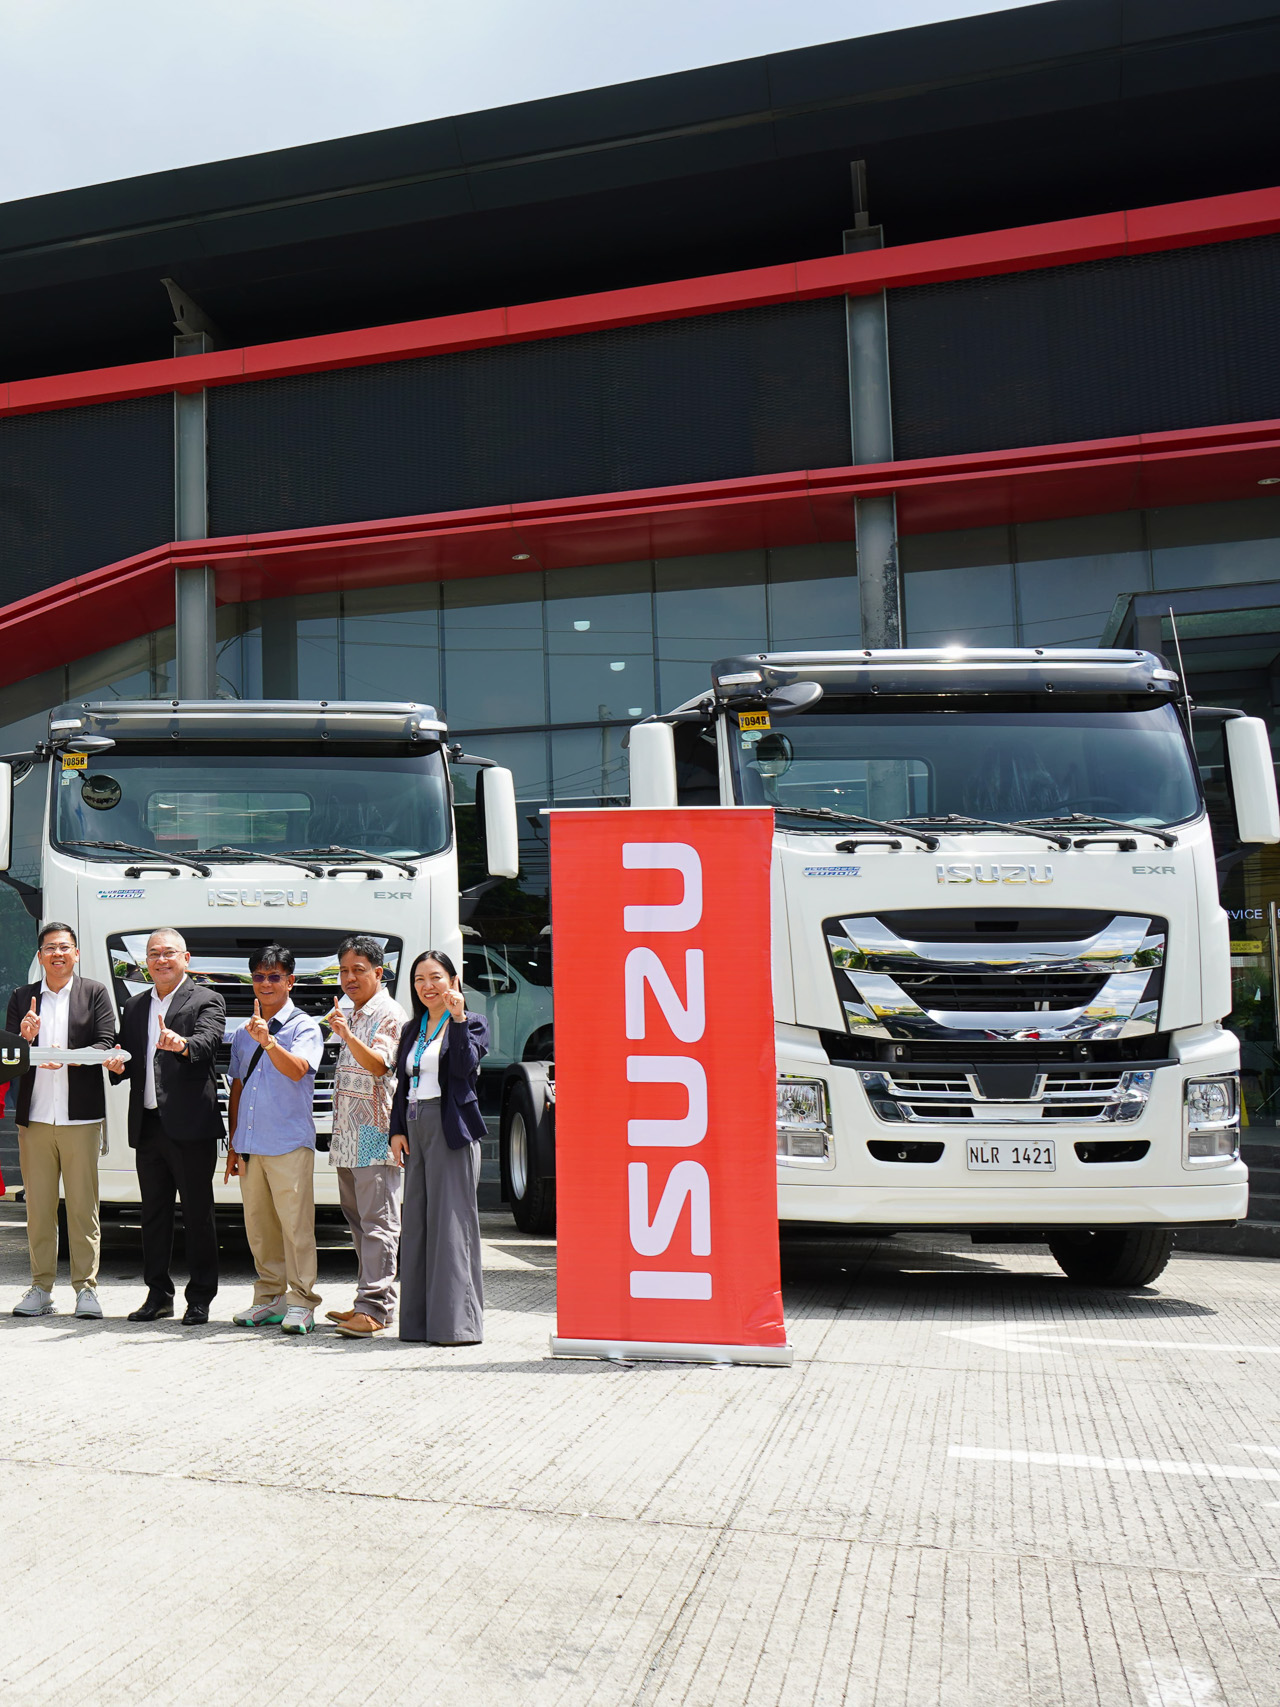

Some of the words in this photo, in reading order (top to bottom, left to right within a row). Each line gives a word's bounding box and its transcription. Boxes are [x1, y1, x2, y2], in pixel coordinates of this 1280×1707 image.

[936, 863, 1054, 885] ISUZU
[1132, 865, 1176, 875] EXR
[207, 888, 308, 906] ISUZU
[373, 891, 413, 900] EXR
[622, 842, 713, 1300] ISUZU
[969, 1146, 1000, 1163] NLR
[1011, 1147, 1053, 1164] 1421
